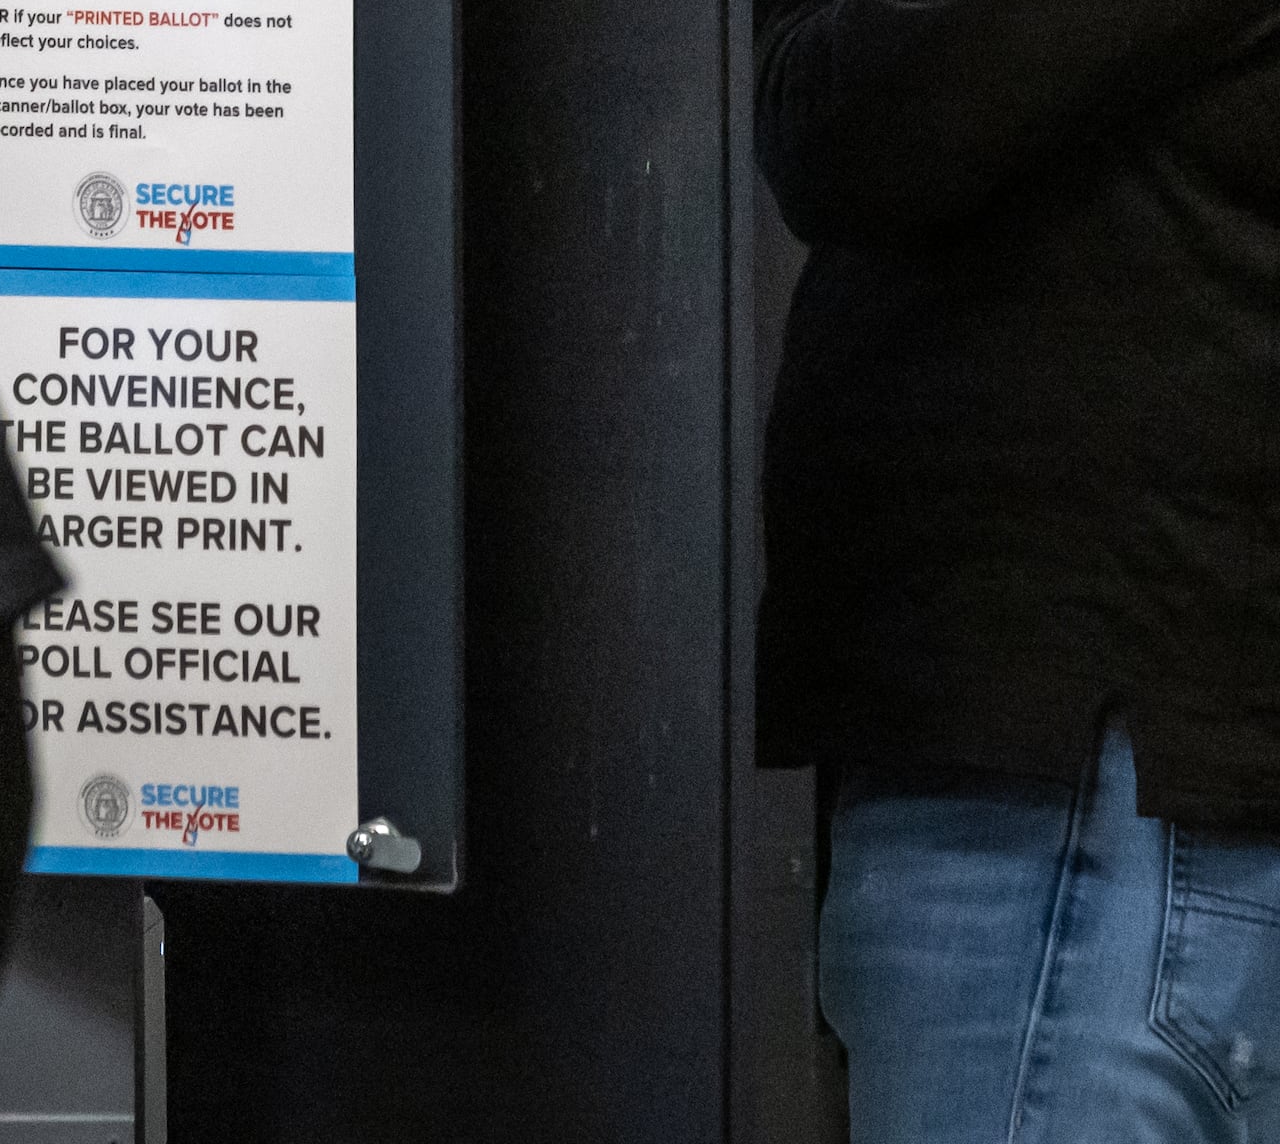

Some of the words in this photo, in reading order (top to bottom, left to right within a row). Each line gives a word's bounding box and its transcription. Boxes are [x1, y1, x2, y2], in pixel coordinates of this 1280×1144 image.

[14, 8, 24, 23] if
[27, 13, 62, 27] your
[224, 13, 262, 28] does
[266, 15, 292, 28] not
[38, 37, 73, 52] your
[77, 34, 139, 50] choices.
[30, 78, 58, 92] you
[63, 75, 100, 90] have
[104, 76, 155, 94] placed
[160, 80, 194, 95] your
[199, 77, 242, 93] ballot
[247, 78, 261, 93] in
[266, 79, 292, 94] the
[99, 100, 132, 117] box,
[136, 104, 170, 119] your
[174, 102, 208, 117] vote
[213, 102, 240, 117] has
[245, 103, 284, 118] been
[58, 124, 87, 138] and
[92, 123, 104, 139] is
[108, 124, 146, 139] final.
[136, 183, 234, 208] SECURE
[136, 210, 177, 229] THE
[59, 326, 135, 360] FOR
[148, 328, 258, 363] YOUR
[12, 372, 305, 416] CONVENIENCE,
[80, 421, 228, 456] BALLOT
[240, 424, 324, 458] CAN
[28, 467, 74, 500] BE
[86, 468, 237, 504] VIEWED
[251, 472, 288, 505] IN
[37, 514, 163, 549] ARGER
[177, 517, 302, 552] PRINT.
[23, 599, 138, 633] LEASE
[151, 601, 221, 635] SEE
[234, 603, 320, 638] OUR
[124, 646, 301, 684] OFFICIAL
[76, 700, 332, 740] ASSISTANCE.
[141, 783, 239, 810] SECURE
[142, 811, 182, 830] THE
